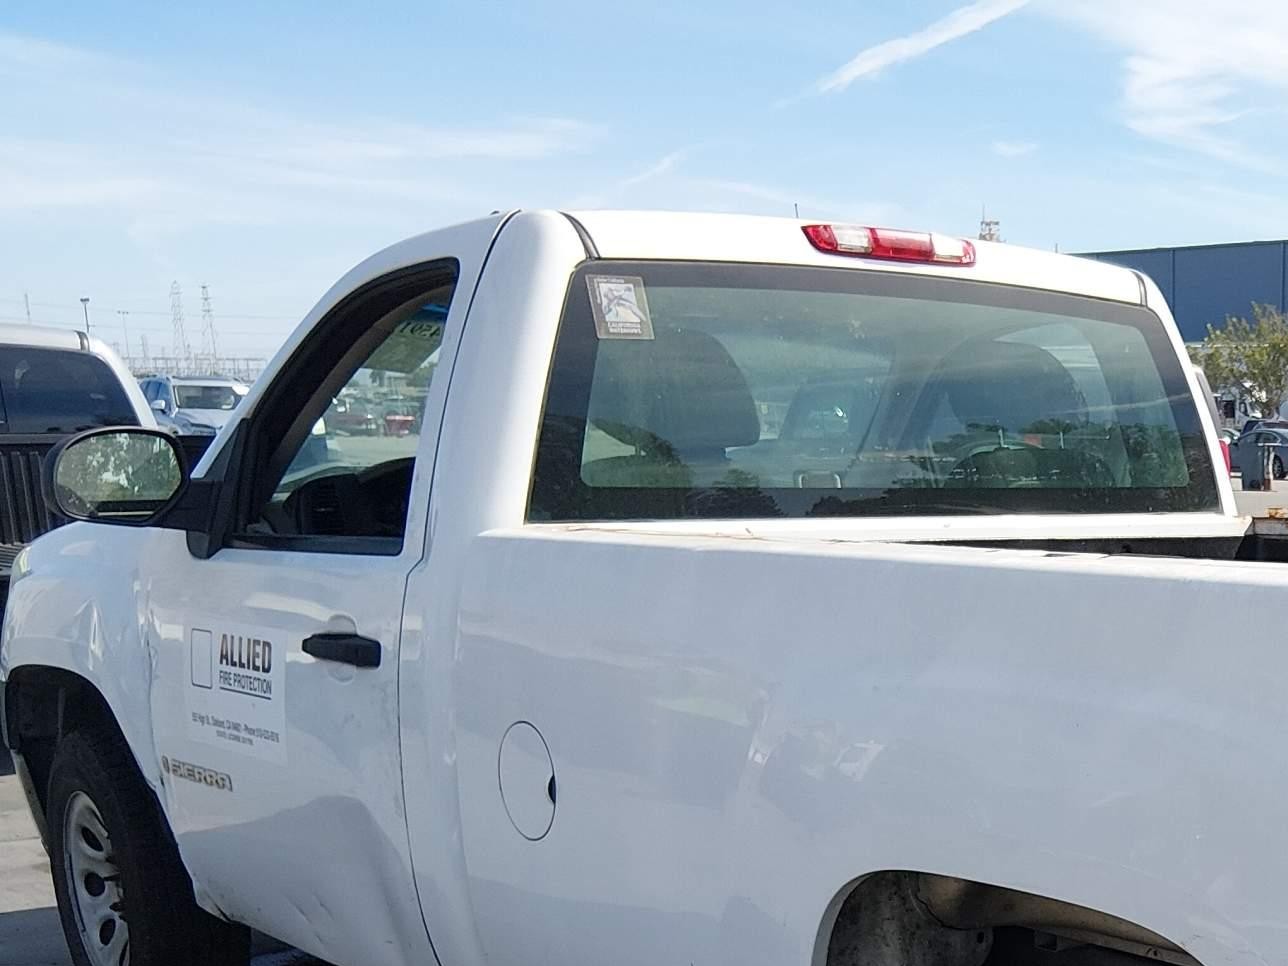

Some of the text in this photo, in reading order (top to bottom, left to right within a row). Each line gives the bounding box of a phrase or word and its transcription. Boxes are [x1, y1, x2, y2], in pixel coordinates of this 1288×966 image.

[219, 633, 272, 673] ALLIED
[219, 670, 272, 695] FIRE PROTECTION
[171, 758, 233, 792] SIERRA
